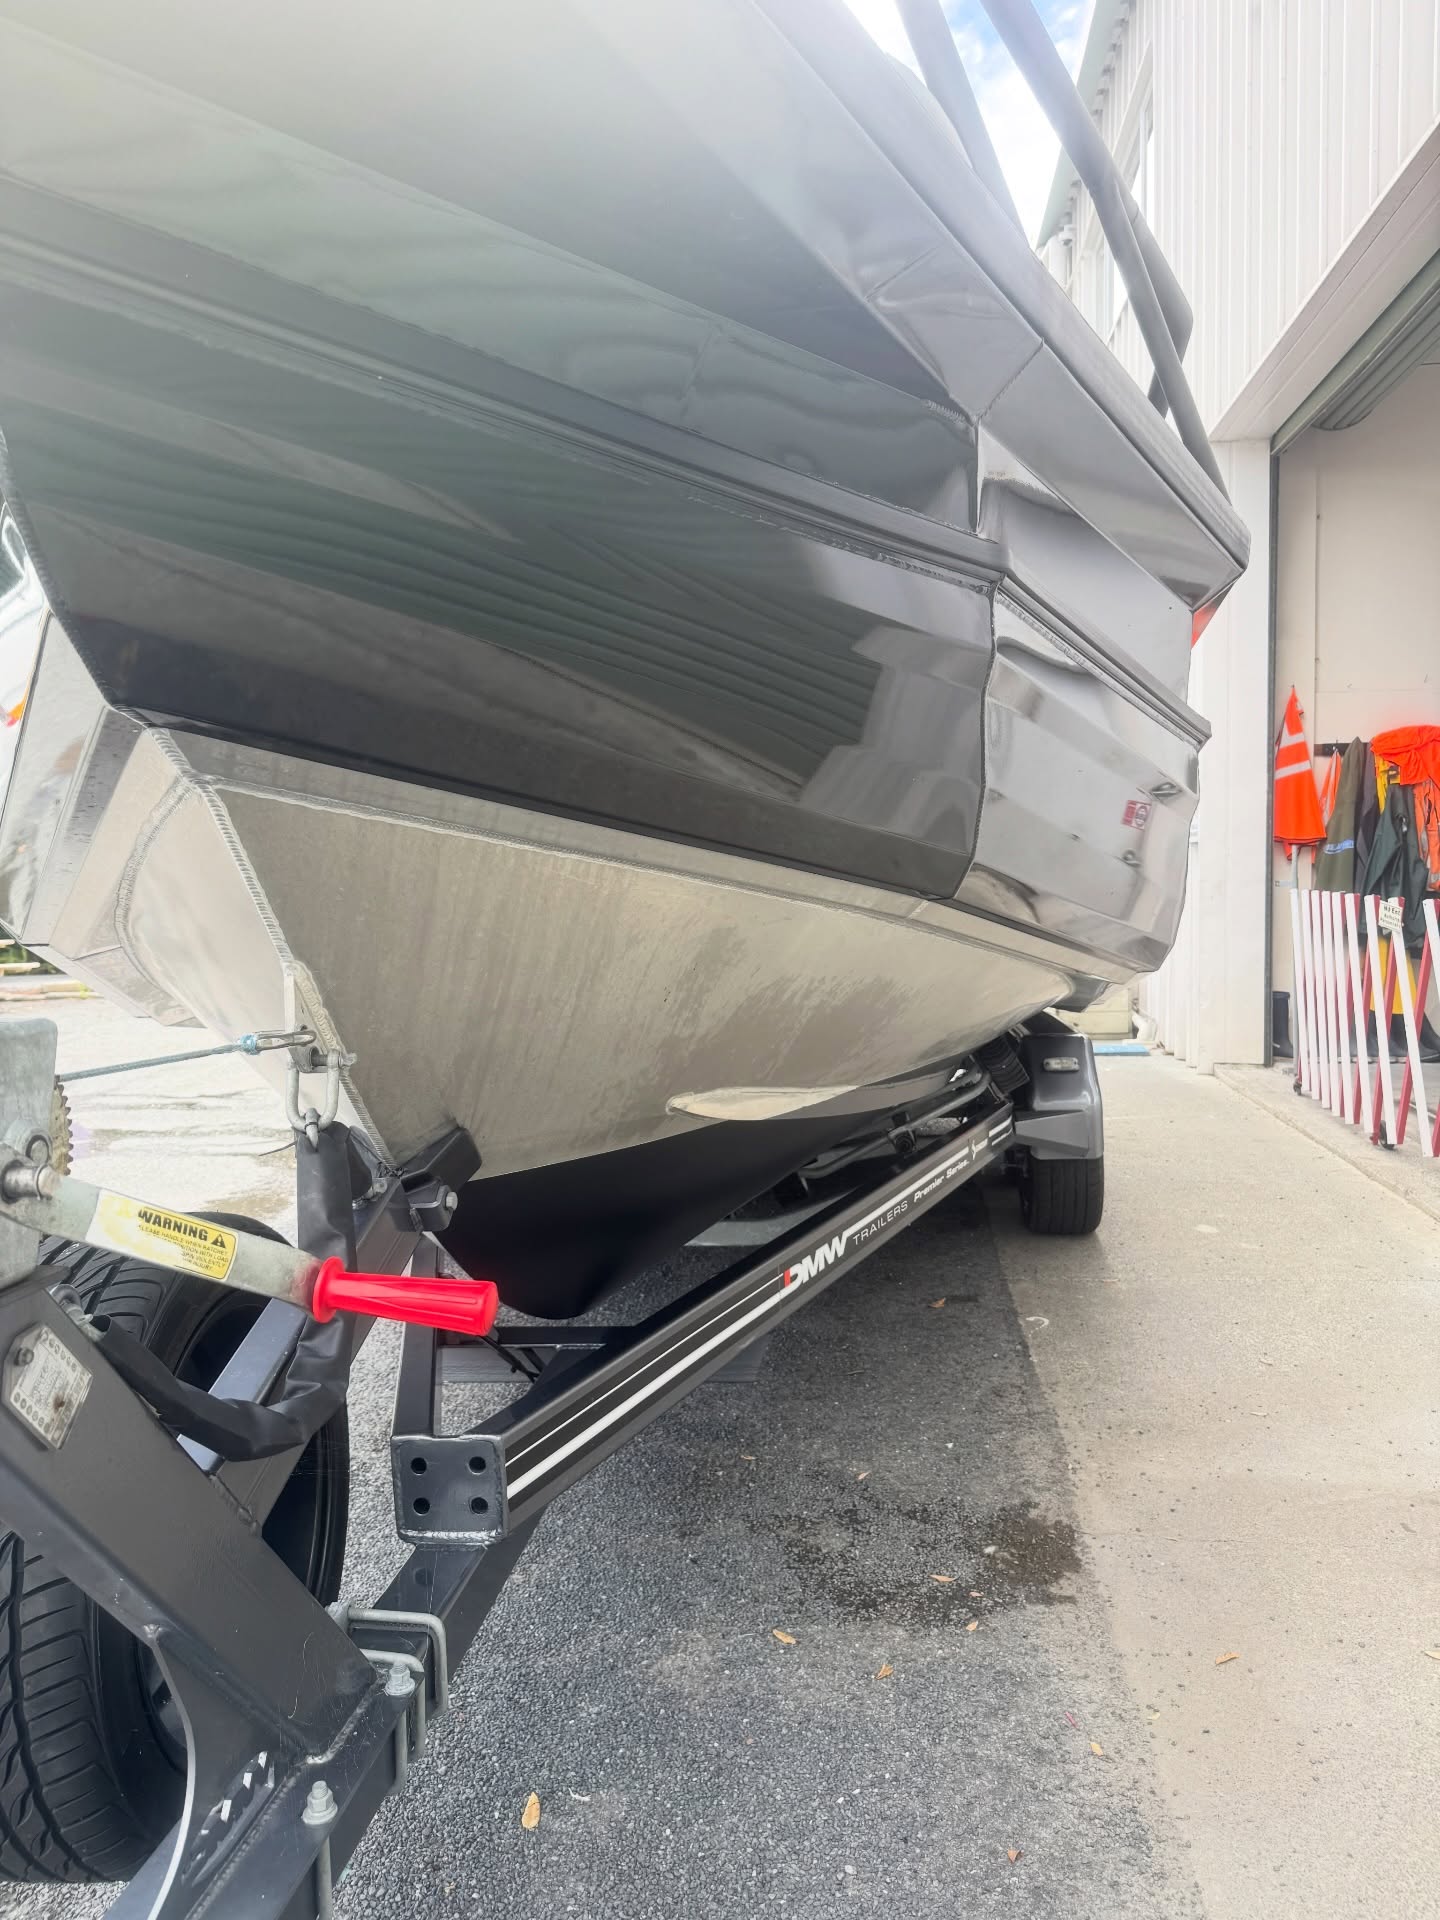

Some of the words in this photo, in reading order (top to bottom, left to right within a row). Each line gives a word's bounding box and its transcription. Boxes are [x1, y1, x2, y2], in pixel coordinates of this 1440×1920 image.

[138, 1209, 208, 1242] WARNING
[784, 1231, 847, 1289] DMW
[853, 1200, 908, 1246] TRAILERS
[913, 1175, 945, 1203] Premier
